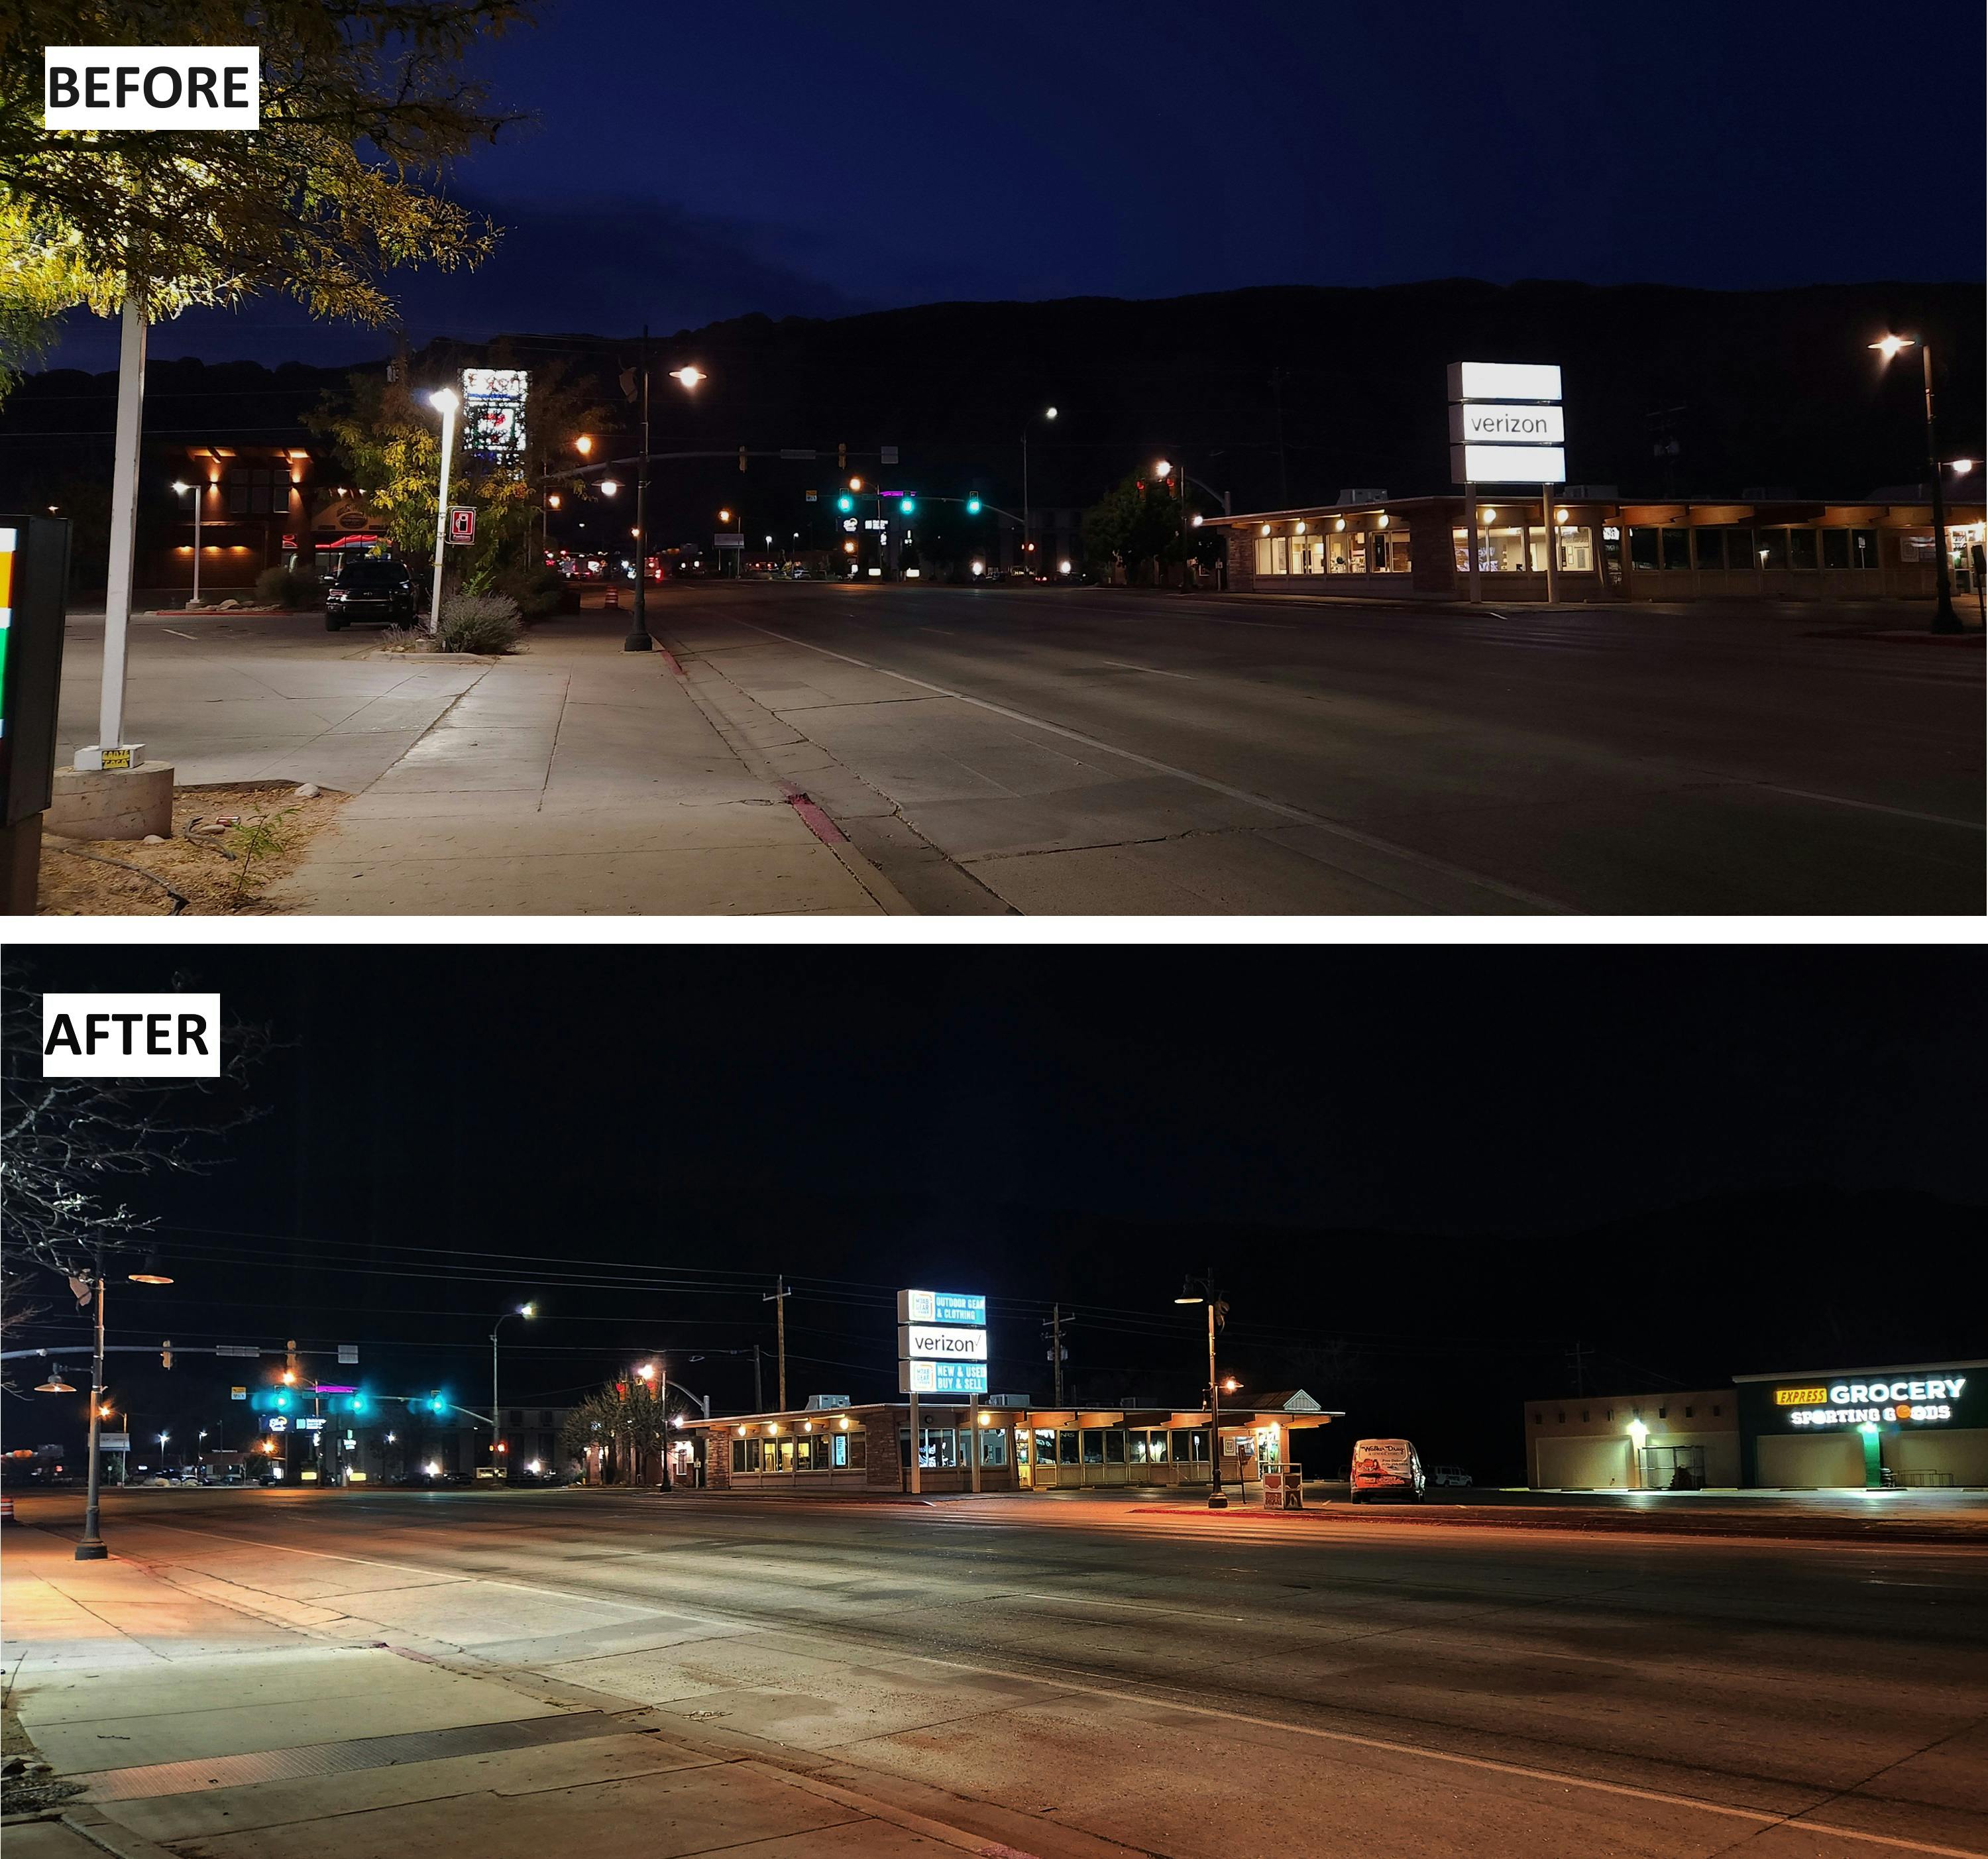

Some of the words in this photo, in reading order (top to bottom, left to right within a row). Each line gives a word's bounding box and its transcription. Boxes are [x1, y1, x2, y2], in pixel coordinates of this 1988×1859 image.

[1471, 414, 1547, 433] verizon
[936, 1296, 966, 1308] OUTDOOR
[936, 1307, 943, 1318] &
[944, 1308, 975, 1320] CLOTHING
[915, 1335, 973, 1352] verizon
[937, 1365, 954, 1377] NEW
[957, 1365, 964, 1377] &
[938, 1377, 954, 1389] BUY
[956, 1378, 963, 1390] &
[964, 1378, 983, 1390] SELL
[1780, 1390, 1825, 1402] EXPRESS
[1830, 1379, 1967, 1404] GROCERY
[1791, 1408, 1881, 1425] SPORTING
[1385, 1445, 1404, 1455] Drug
